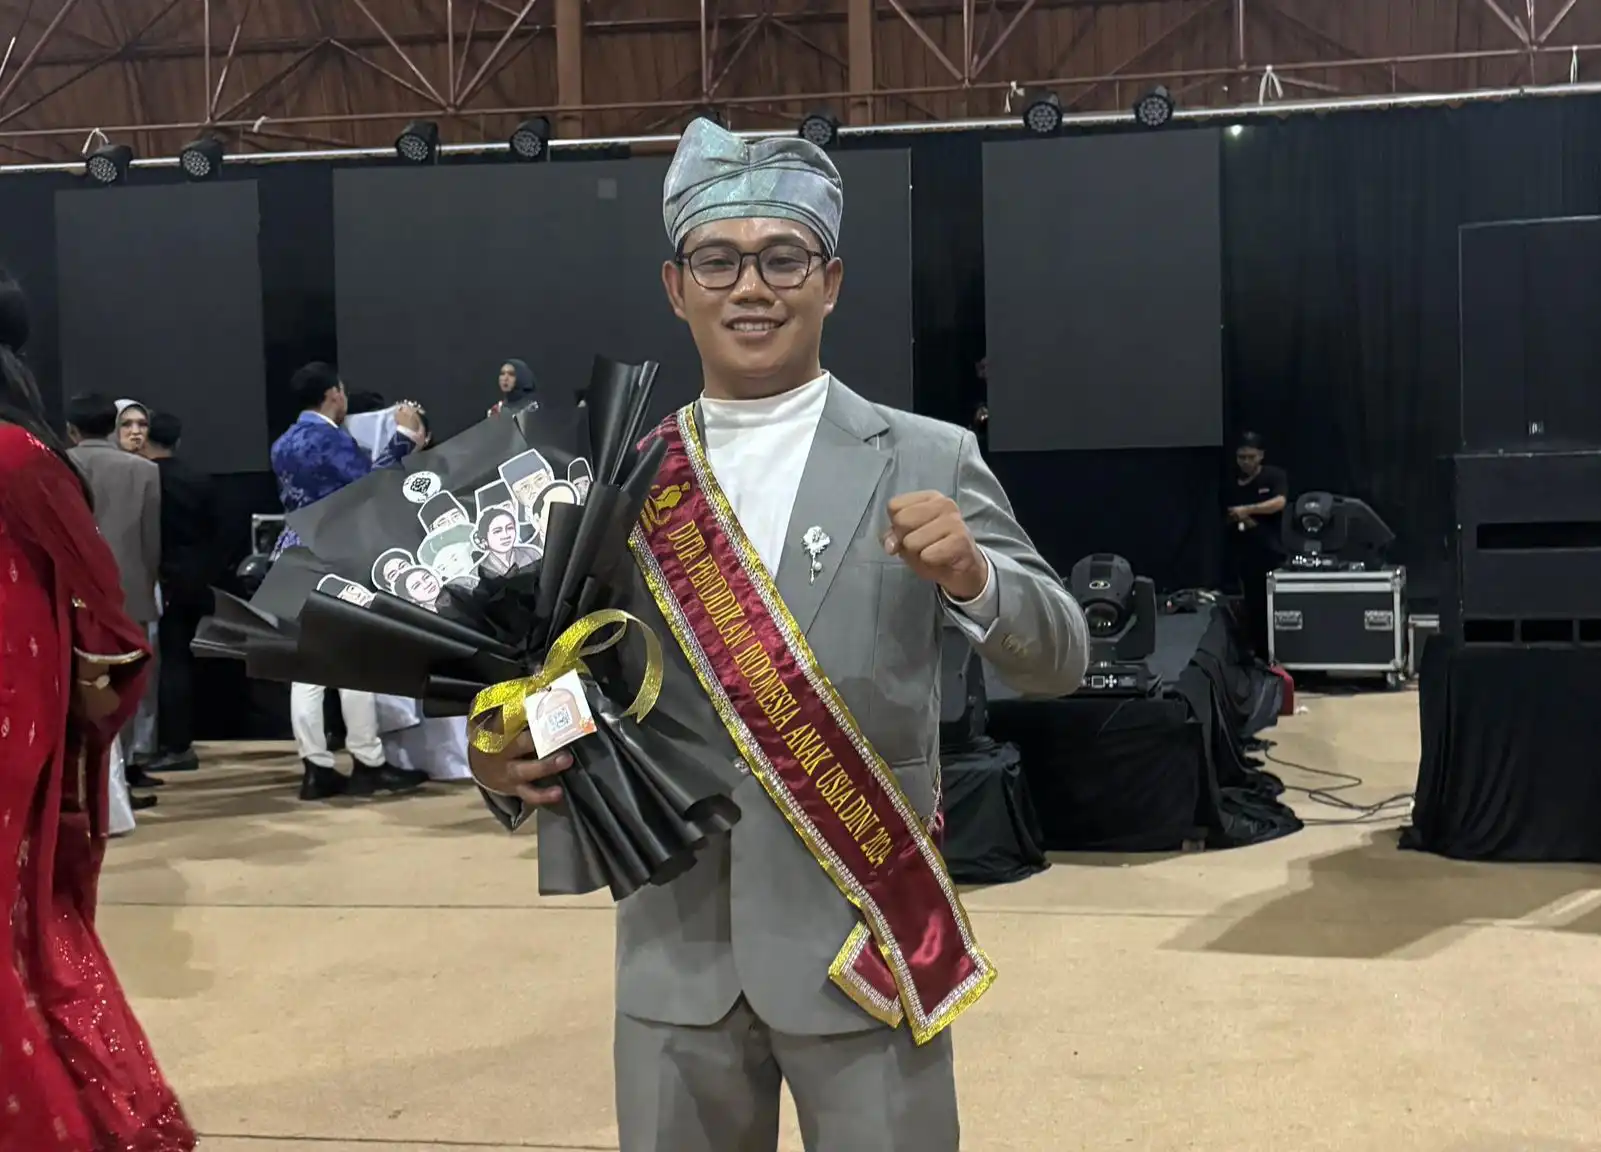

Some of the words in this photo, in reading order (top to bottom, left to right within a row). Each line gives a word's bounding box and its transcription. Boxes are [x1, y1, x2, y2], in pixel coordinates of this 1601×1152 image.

[667, 520, 703, 561] DUTA
[688, 556, 754, 646] PENDIDIKAN
[734, 642, 797, 730] INDONESIA
[783, 723, 832, 776] ANAK
[816, 763, 854, 810] USIA
[839, 795, 879, 841] DINI
[860, 826, 894, 868] 2024
